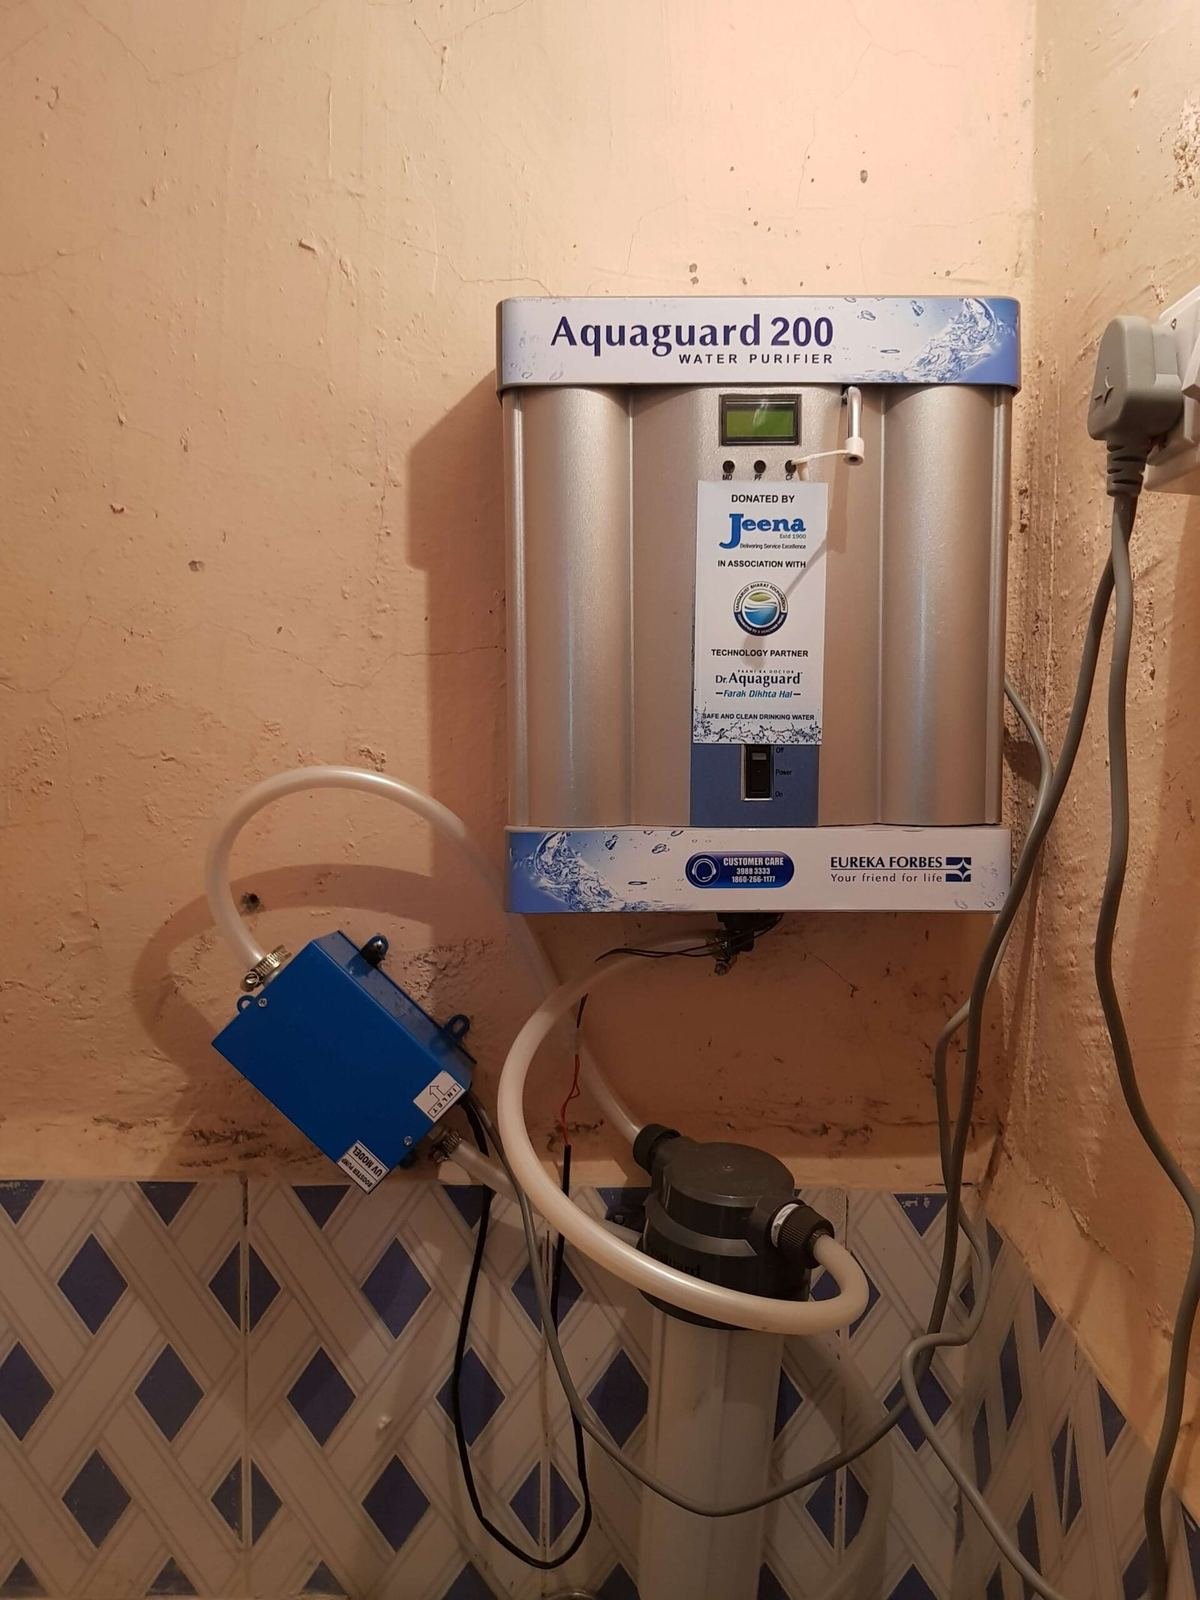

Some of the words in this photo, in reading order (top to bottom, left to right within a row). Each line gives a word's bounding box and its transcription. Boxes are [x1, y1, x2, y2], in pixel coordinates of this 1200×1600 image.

[551, 314, 760, 357] Aquaguard
[770, 316, 834, 347] 200
[679, 353, 738, 365] WATER
[749, 353, 833, 365] PURIFIER
[731, 494, 779, 504] DONATED
[781, 495, 795, 504] BY
[719, 513, 807, 550] Jeena
[718, 560, 726, 568] IN
[727, 560, 783, 568] ASSOCIATION
[785, 561, 807, 569] WITH
[711, 649, 768, 658] TECHNOLOGY
[769, 650, 809, 658] PARTNER
[728, 672, 801, 688] Aquaguard
[775, 768, 793, 776] Power
[774, 790, 784, 798] On
[723, 857, 764, 866] CUSTOMER
[764, 857, 784, 866] CARE
[830, 856, 886, 868] EUREKA
[889, 856, 943, 868] FORBES
[831, 872, 855, 882] Your
[862, 872, 896, 882] friend
[901, 872, 918, 882] for
[923, 872, 943, 882] life
[352, 1145, 375, 1169] MODEL
[371, 1165, 383, 1178] UV
